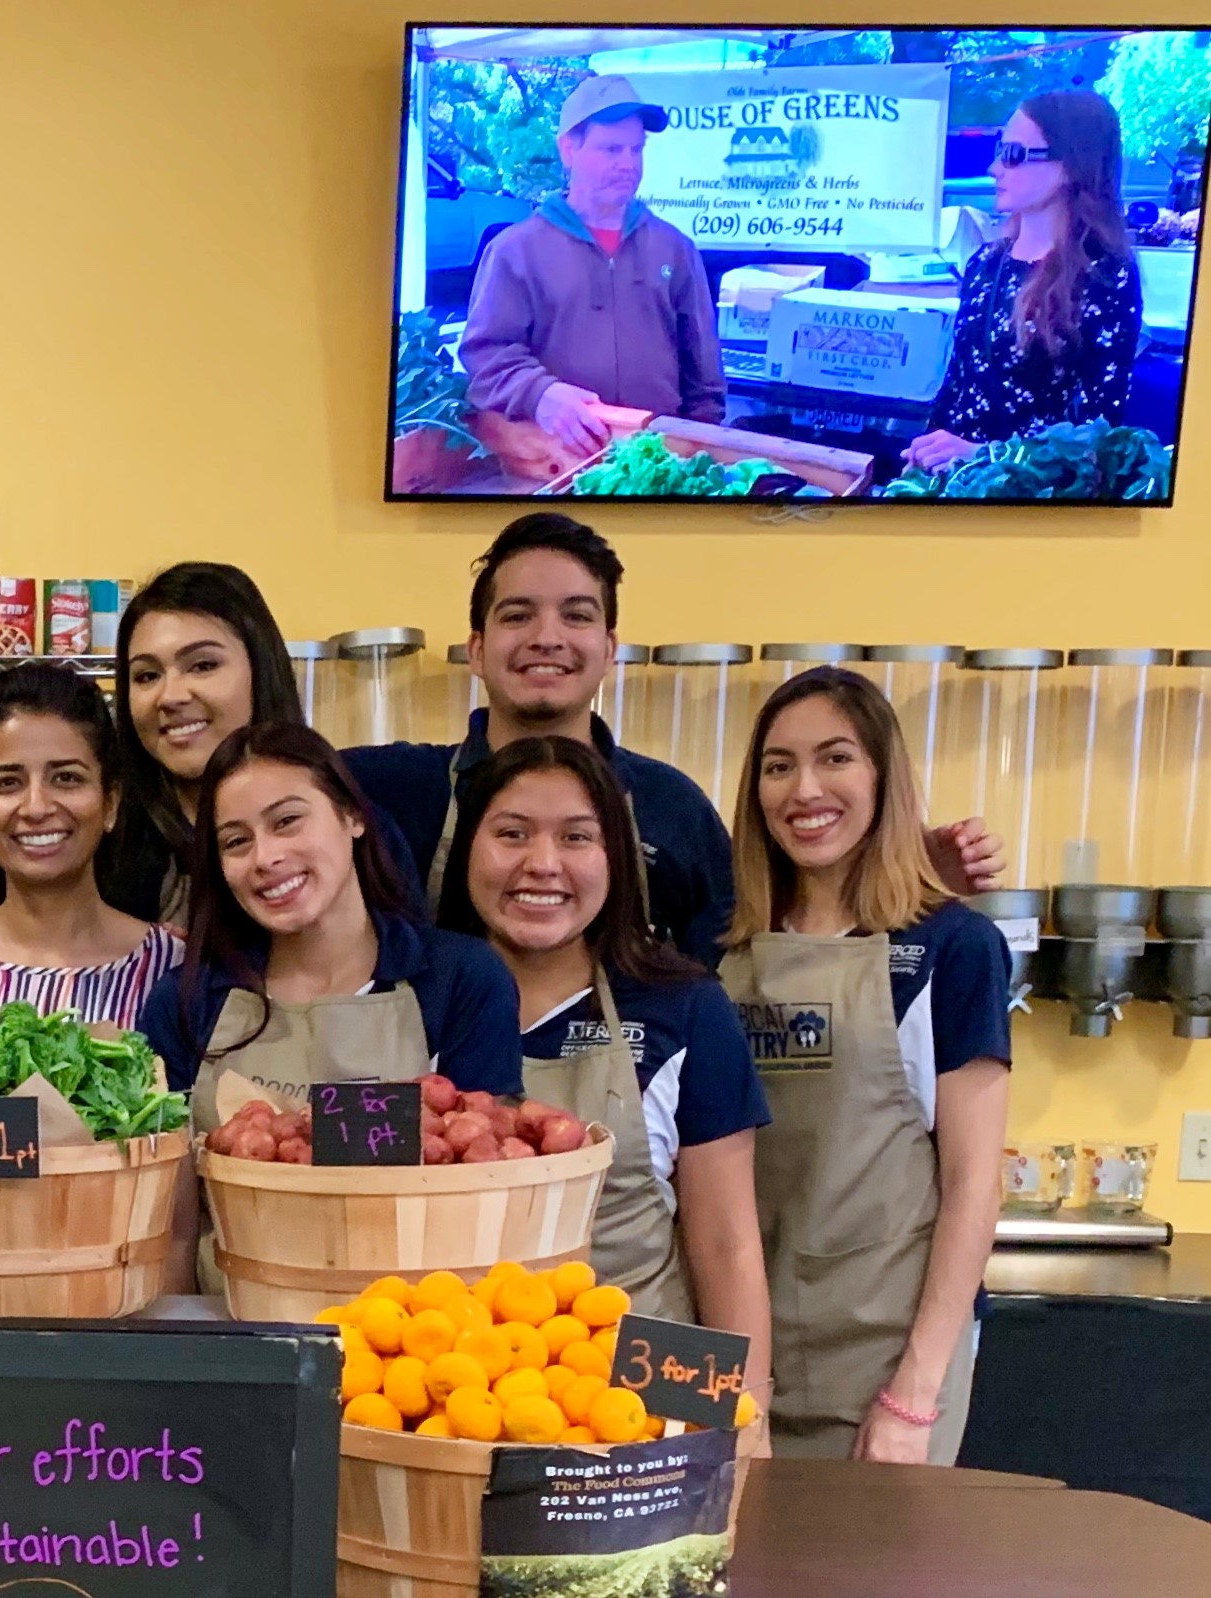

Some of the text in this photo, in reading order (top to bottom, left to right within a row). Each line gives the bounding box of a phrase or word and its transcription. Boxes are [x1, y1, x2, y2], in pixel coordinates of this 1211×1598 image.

[668, 93, 900, 130] OUSE OF GREENS
[727, 178, 801, 196] Microgreens
[805, 176, 818, 190] &
[823, 175, 860, 190] Herbs
[634, 194, 925, 213] droponically Grown GMO Free No Pesticides
[692, 213, 844, 237] (209) 606-9544
[813, 311, 896, 330] MARKON
[808, 351, 847, 365] FIRST
[889, 944, 926, 957] ERCED
[739, 1003, 788, 1031] BCAT
[566, 1024, 645, 1043] MERED
[745, 1031, 789, 1058] TRY
[320, 1087, 344, 1115] 2
[360, 1087, 400, 1112] for
[339, 1121, 406, 1157] 1 pt.
[620, 1339, 653, 1390] 3
[661, 1355, 699, 1383] for
[32, 1417, 205, 1486] efforts
[545, 1453, 689, 1479] Brought to you by:
[552, 1469, 687, 1492] The Food Commons
[539, 1495, 571, 1507] 202
[575, 1495, 607, 1506] Van
[611, 1490, 651, 1504] Ness
[546, 1509, 608, 1522] Fresno,
[613, 1506, 635, 1519] CA
